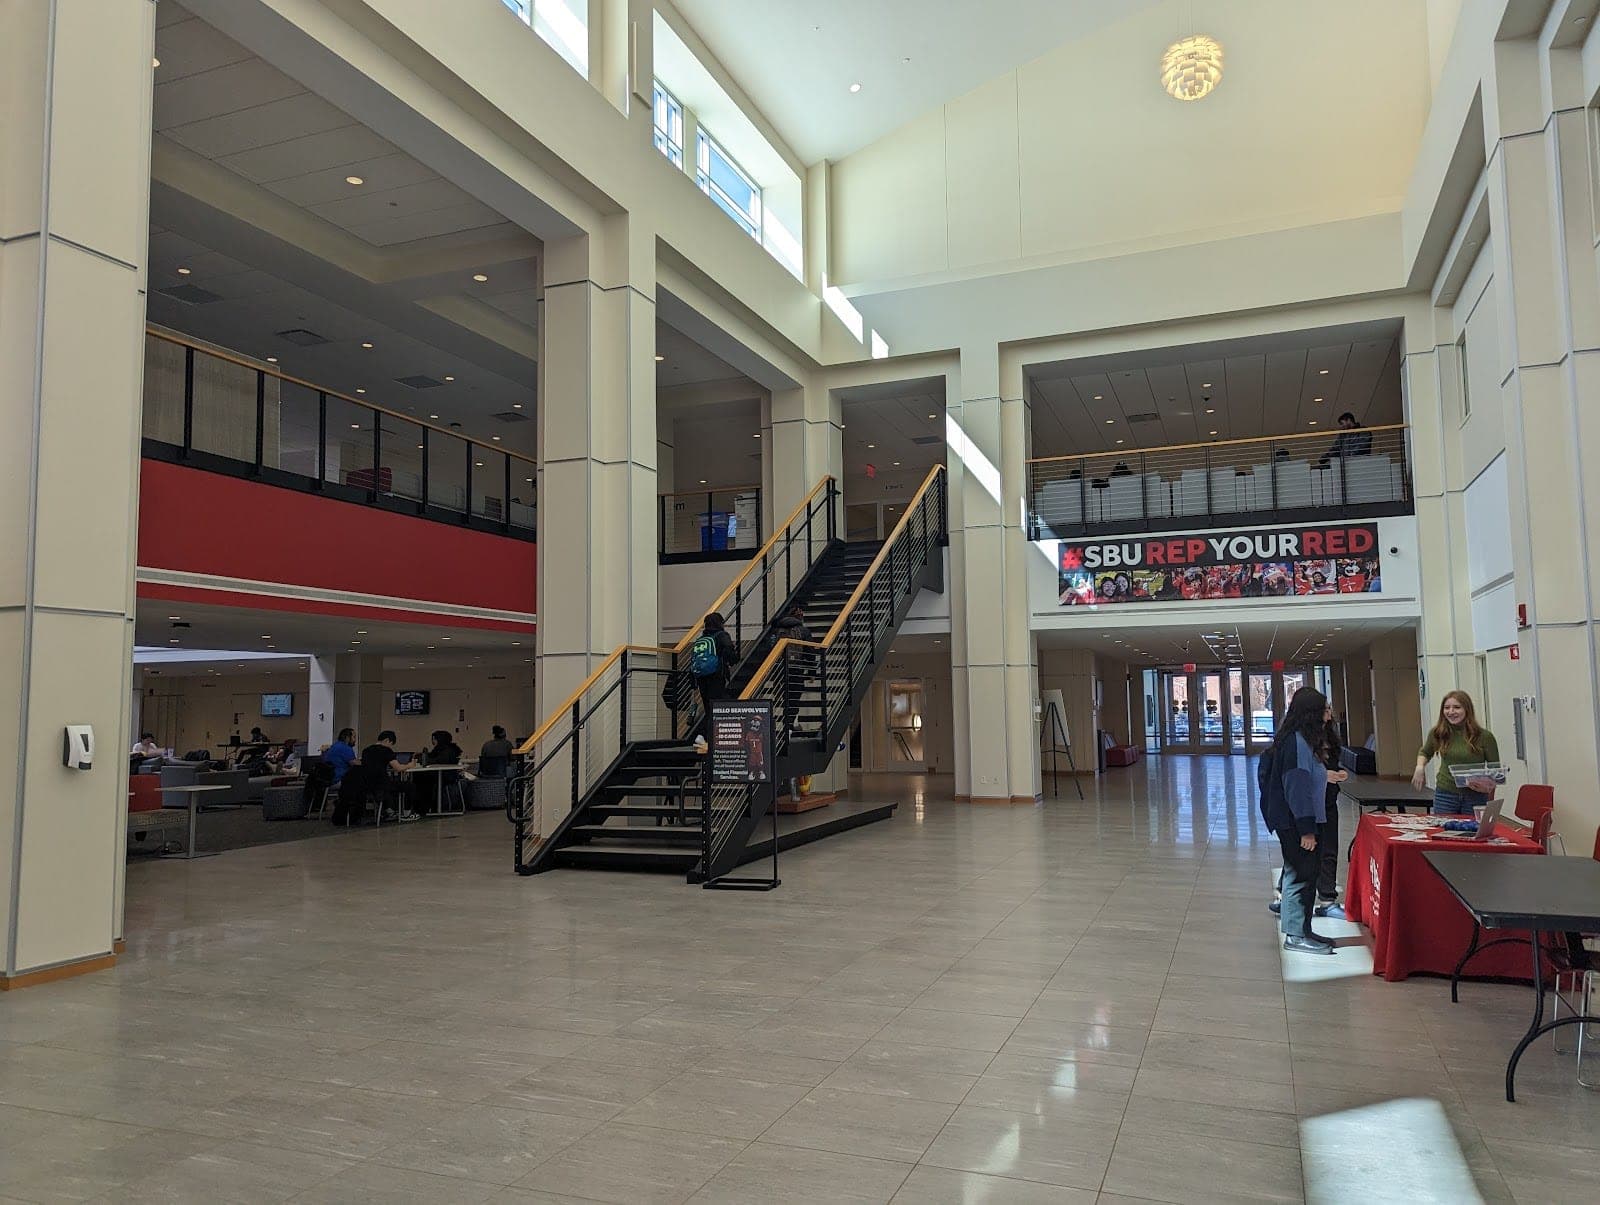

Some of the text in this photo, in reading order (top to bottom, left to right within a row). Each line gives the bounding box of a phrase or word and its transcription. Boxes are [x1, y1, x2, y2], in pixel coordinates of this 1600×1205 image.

[1062, 528, 1374, 571] #SBU REP YOUR RED
